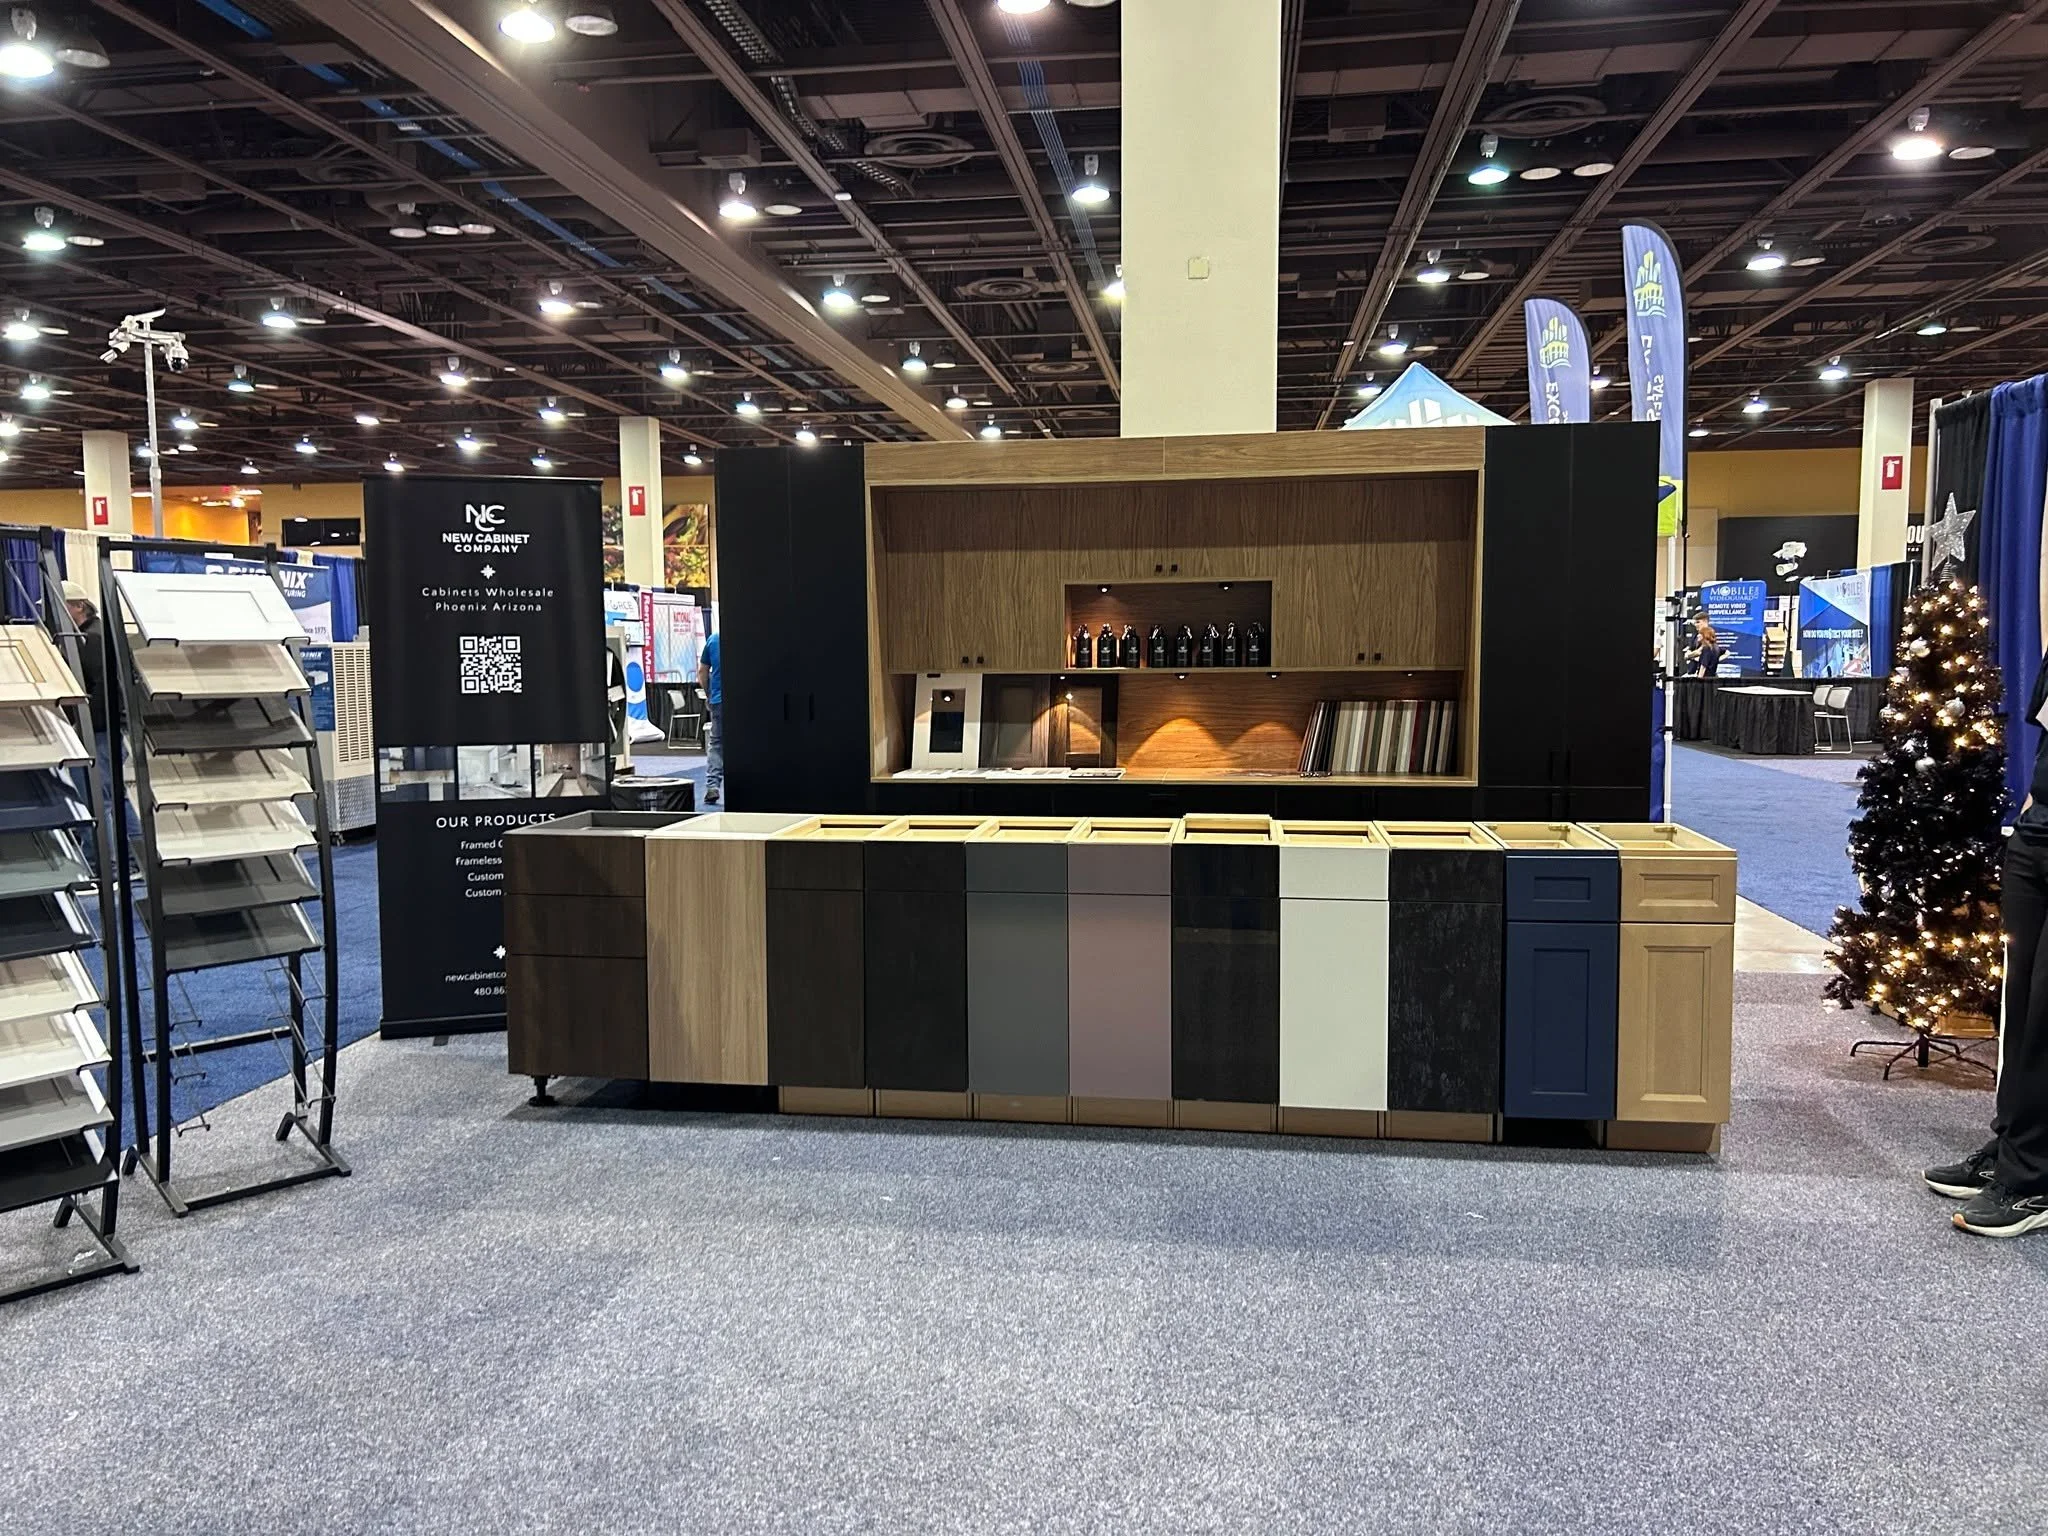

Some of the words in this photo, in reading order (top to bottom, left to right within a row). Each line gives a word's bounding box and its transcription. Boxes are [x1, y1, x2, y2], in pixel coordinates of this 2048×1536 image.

[442, 533, 474, 543] NEW
[475, 533, 530, 544] CABINET
[454, 544, 519, 553] COMPANY
[422, 587, 480, 597] Cabinets
[485, 587, 554, 597] Wholesale
[1709, 586, 1755, 596] MOBILE
[435, 602, 487, 612] Phoenix
[493, 602, 542, 612] Arizona
[436, 816, 469, 828] OUR
[475, 813, 556, 827] PRODUCTS
[460, 840, 496, 850] Framed
[455, 856, 503, 867] Frameless
[467, 872, 504, 882] Custom
[465, 888, 502, 898] Custom
[445, 970, 507, 982] newcabinetco
[474, 987, 507, 996] 480.86
